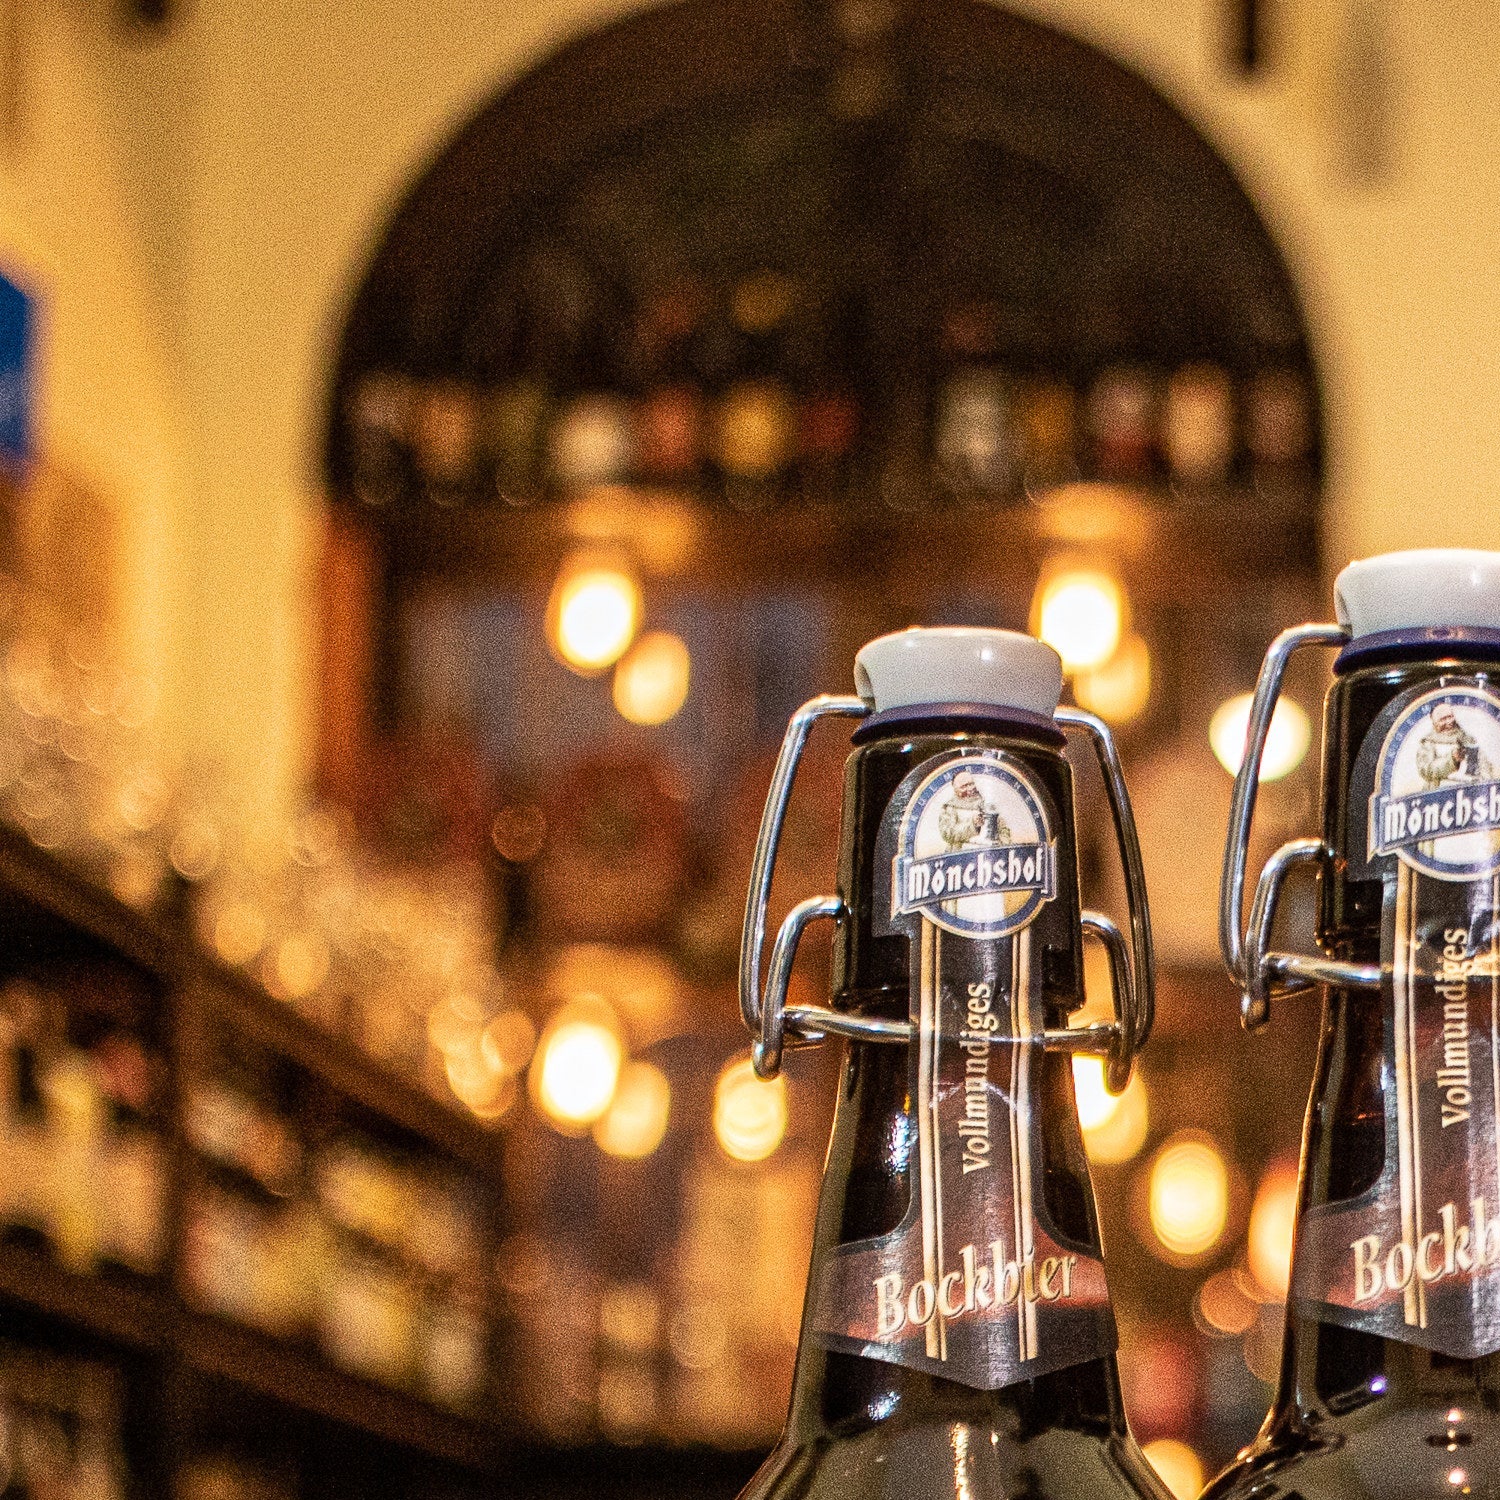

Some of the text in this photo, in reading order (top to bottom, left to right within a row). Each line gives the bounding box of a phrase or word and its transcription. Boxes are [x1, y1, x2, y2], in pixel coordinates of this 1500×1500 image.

[908, 847, 1044, 902] Mönchshof
[958, 982, 999, 1176] Vollmundiges
[1435, 927, 1473, 1129] Vollmundiges
[873, 1240, 1078, 1339] Bockbier
